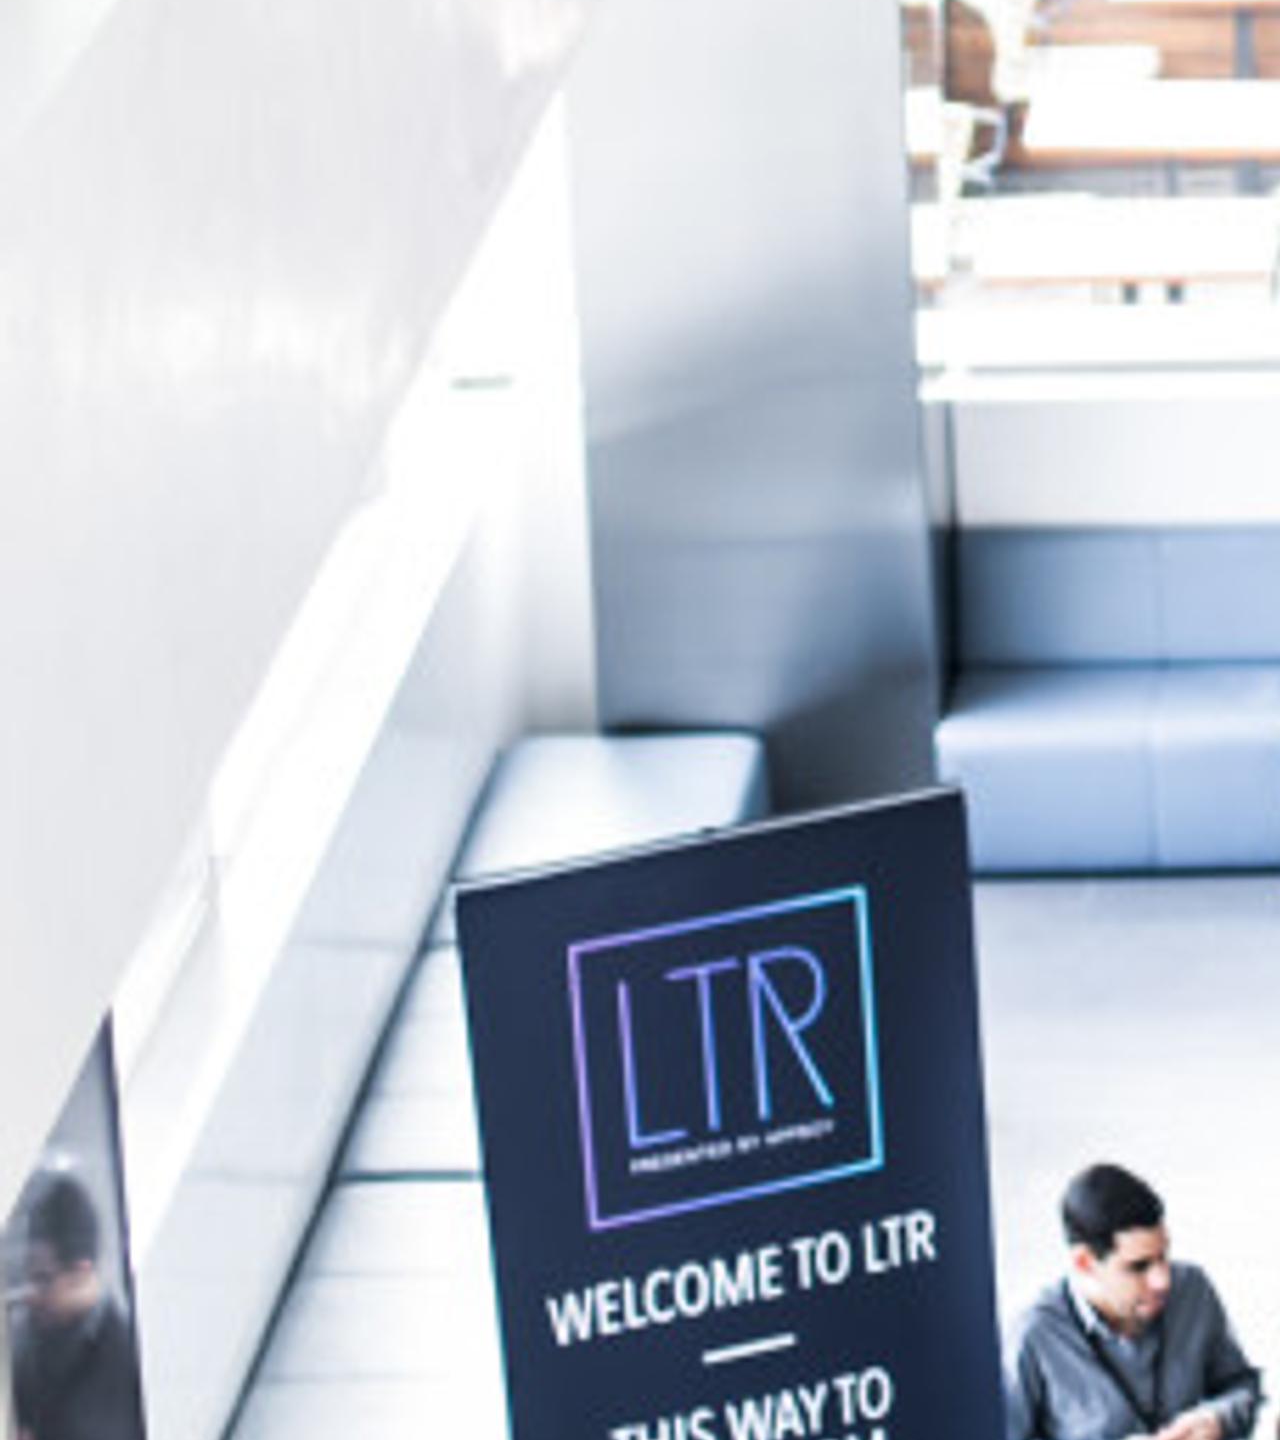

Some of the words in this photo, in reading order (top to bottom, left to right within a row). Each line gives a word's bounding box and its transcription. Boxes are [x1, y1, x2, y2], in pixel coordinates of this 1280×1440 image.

[617, 943, 835, 1150] LTR
[628, 1140, 732, 1175] PRESENTED
[736, 1134, 761, 1154] BY
[545, 1243, 785, 1347] WELCOME
[790, 1230, 851, 1290] TO
[862, 1209, 938, 1274] LTR
[832, 1365, 893, 1425] TO
